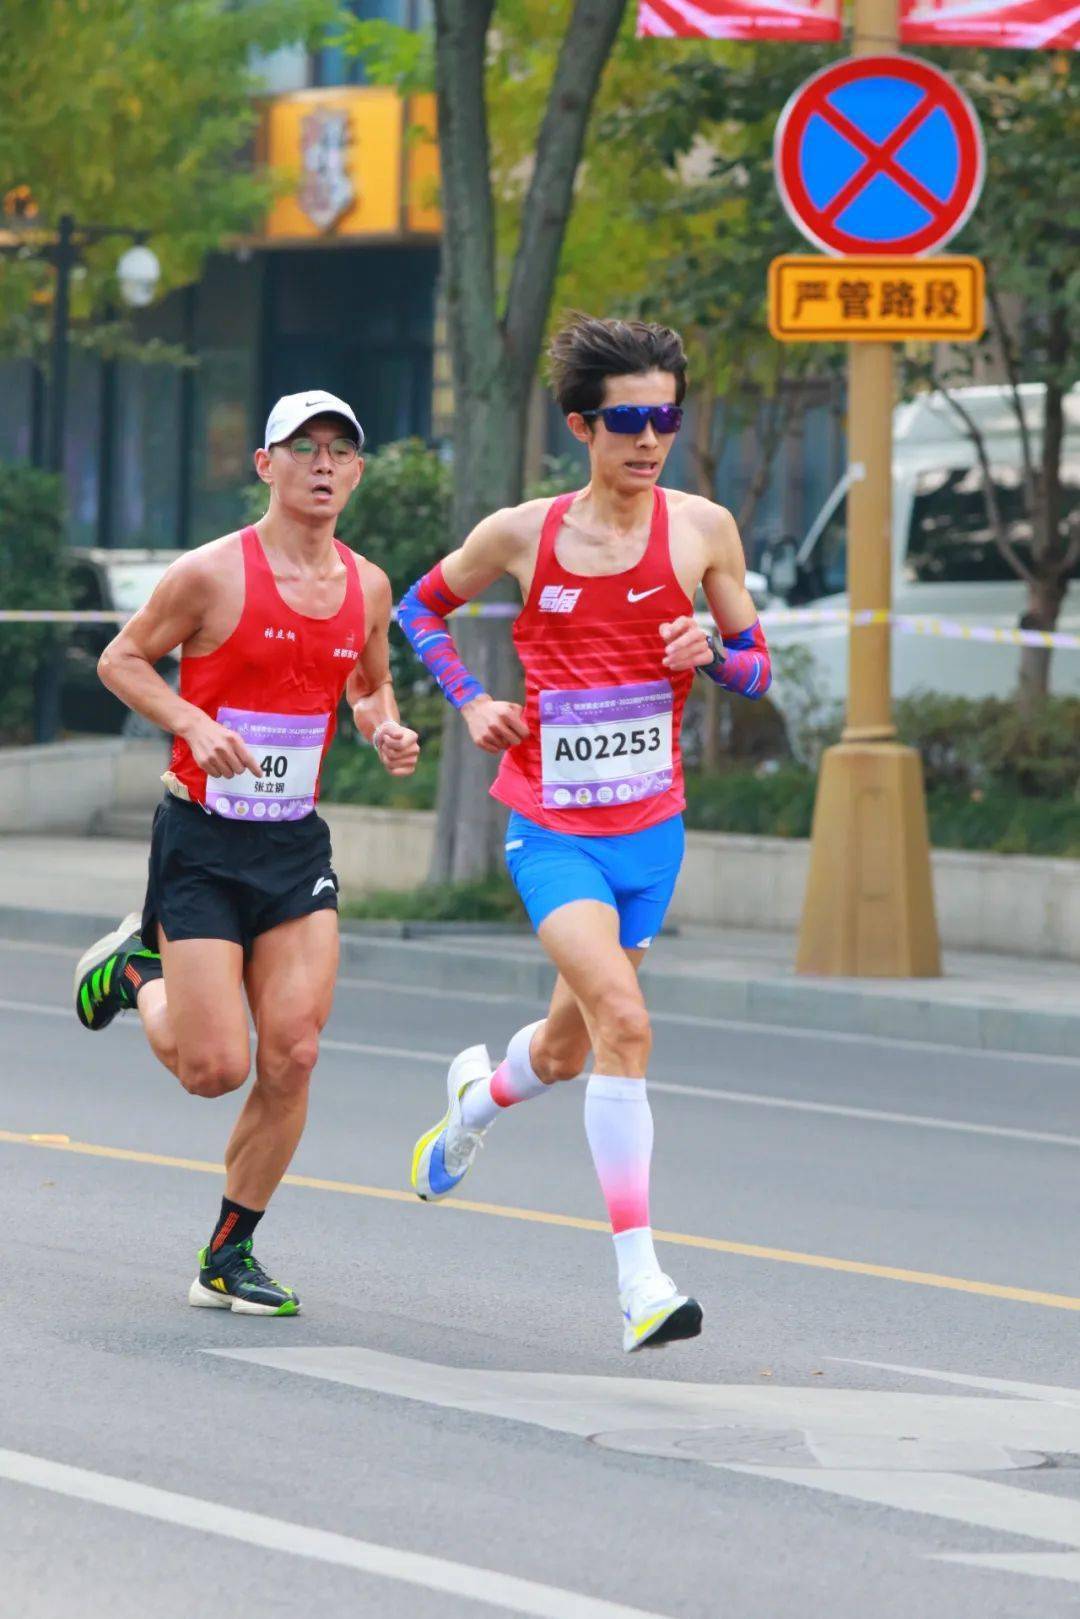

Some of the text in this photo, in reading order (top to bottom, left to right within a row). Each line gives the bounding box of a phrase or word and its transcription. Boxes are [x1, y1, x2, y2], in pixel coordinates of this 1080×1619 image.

[792, 278, 960, 319] 严管路段
[555, 727, 661, 761] A02253
[260, 755, 289, 778] 40
